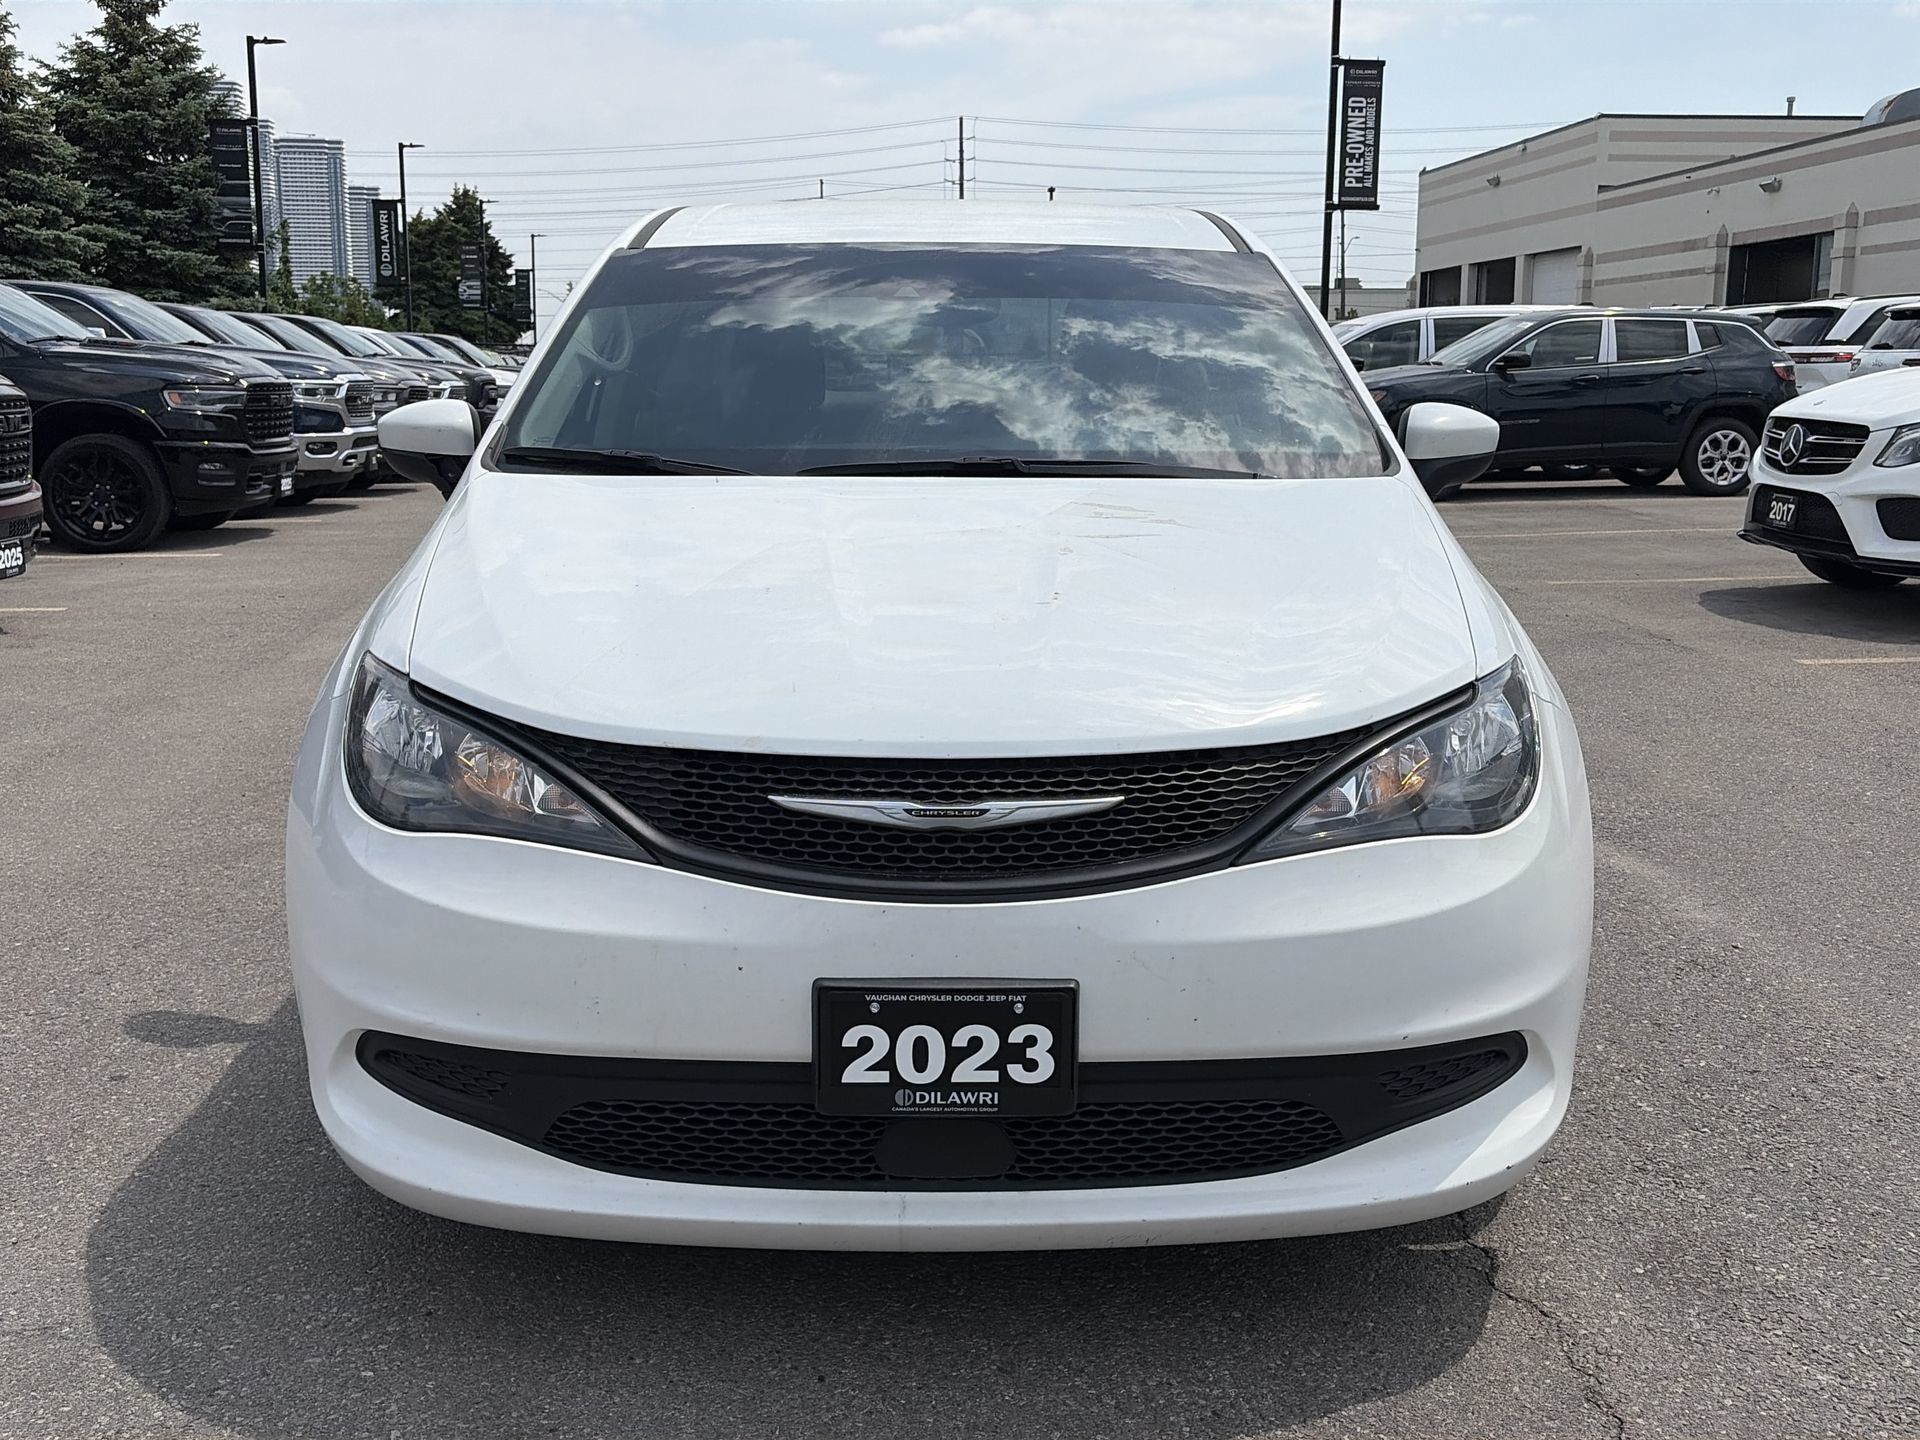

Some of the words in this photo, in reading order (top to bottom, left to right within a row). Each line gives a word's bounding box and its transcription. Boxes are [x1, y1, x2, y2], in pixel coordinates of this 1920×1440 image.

[1366, 97, 1377, 128] MODELS
[1344, 96, 1367, 188] PRE-OWNED
[1365, 129, 1375, 145] AND
[1364, 146, 1374, 173] MAKES
[1363, 173, 1373, 188] ALL
[379, 209, 391, 262] DILAWRI
[1769, 500, 1796, 522] 2017
[0, 546, 23, 569] 2025
[908, 994, 952, 1002] CHRYSLER
[953, 994, 985, 1002] DODGE
[841, 1023, 1056, 1085] 2023
[915, 1091, 999, 1105] DILAWRI
